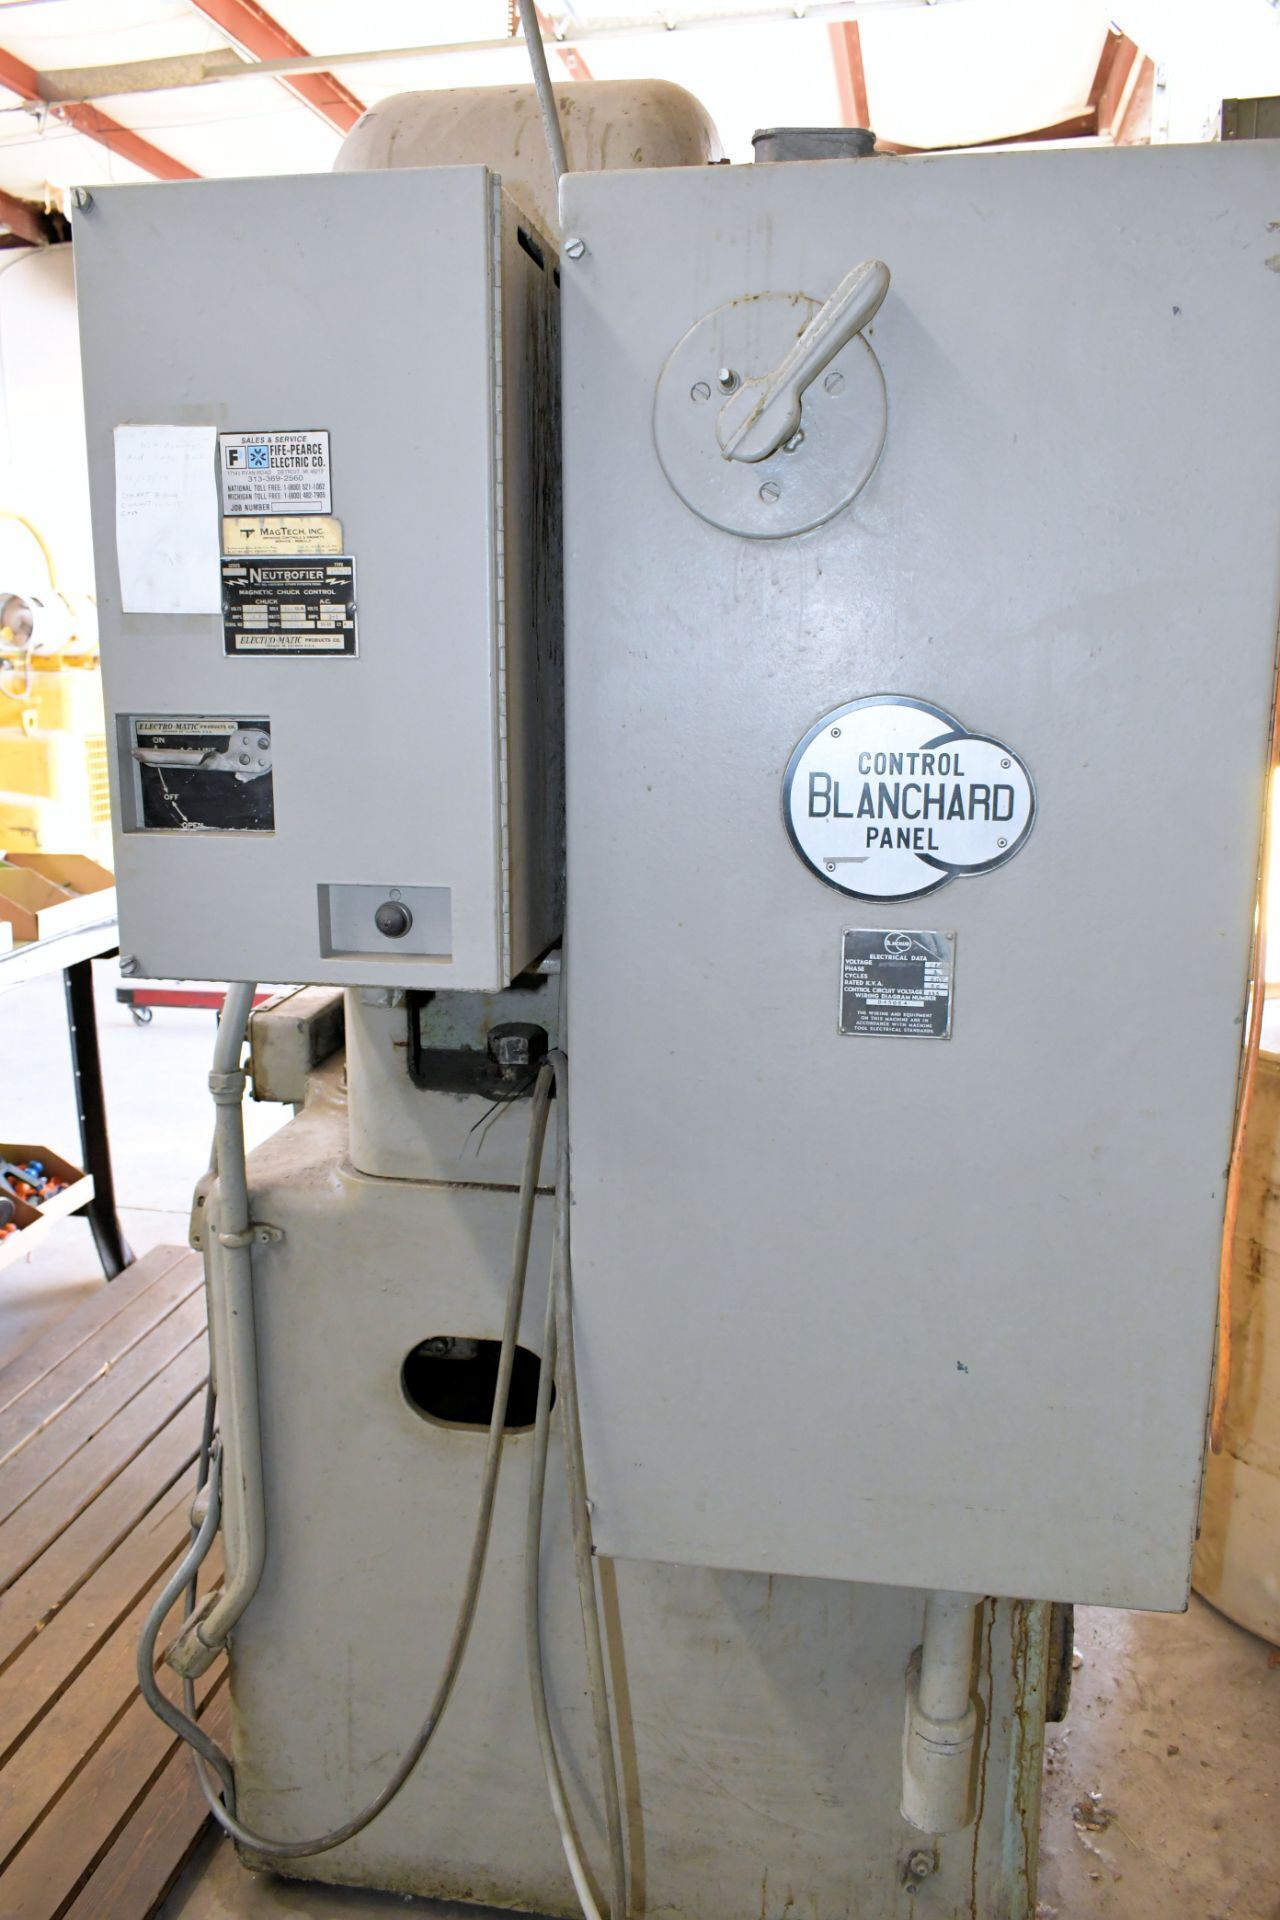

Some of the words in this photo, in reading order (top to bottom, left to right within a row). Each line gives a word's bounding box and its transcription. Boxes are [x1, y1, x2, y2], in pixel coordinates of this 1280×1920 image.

[274, 435, 307, 443] SERVICE
[270, 443, 323, 456] FIFE-PEARCE
[270, 456, 309, 468] ELECTRIC
[311, 456, 326, 467] CO.
[247, 474, 304, 482] 313-369-2560
[244, 503, 270, 511] NUMBER
[249, 568, 324, 583] NEUTROFIER
[857, 751, 965, 777] CONTROL
[808, 771, 1015, 822] BLANCHARD
[866, 827, 939, 850] PANEL
